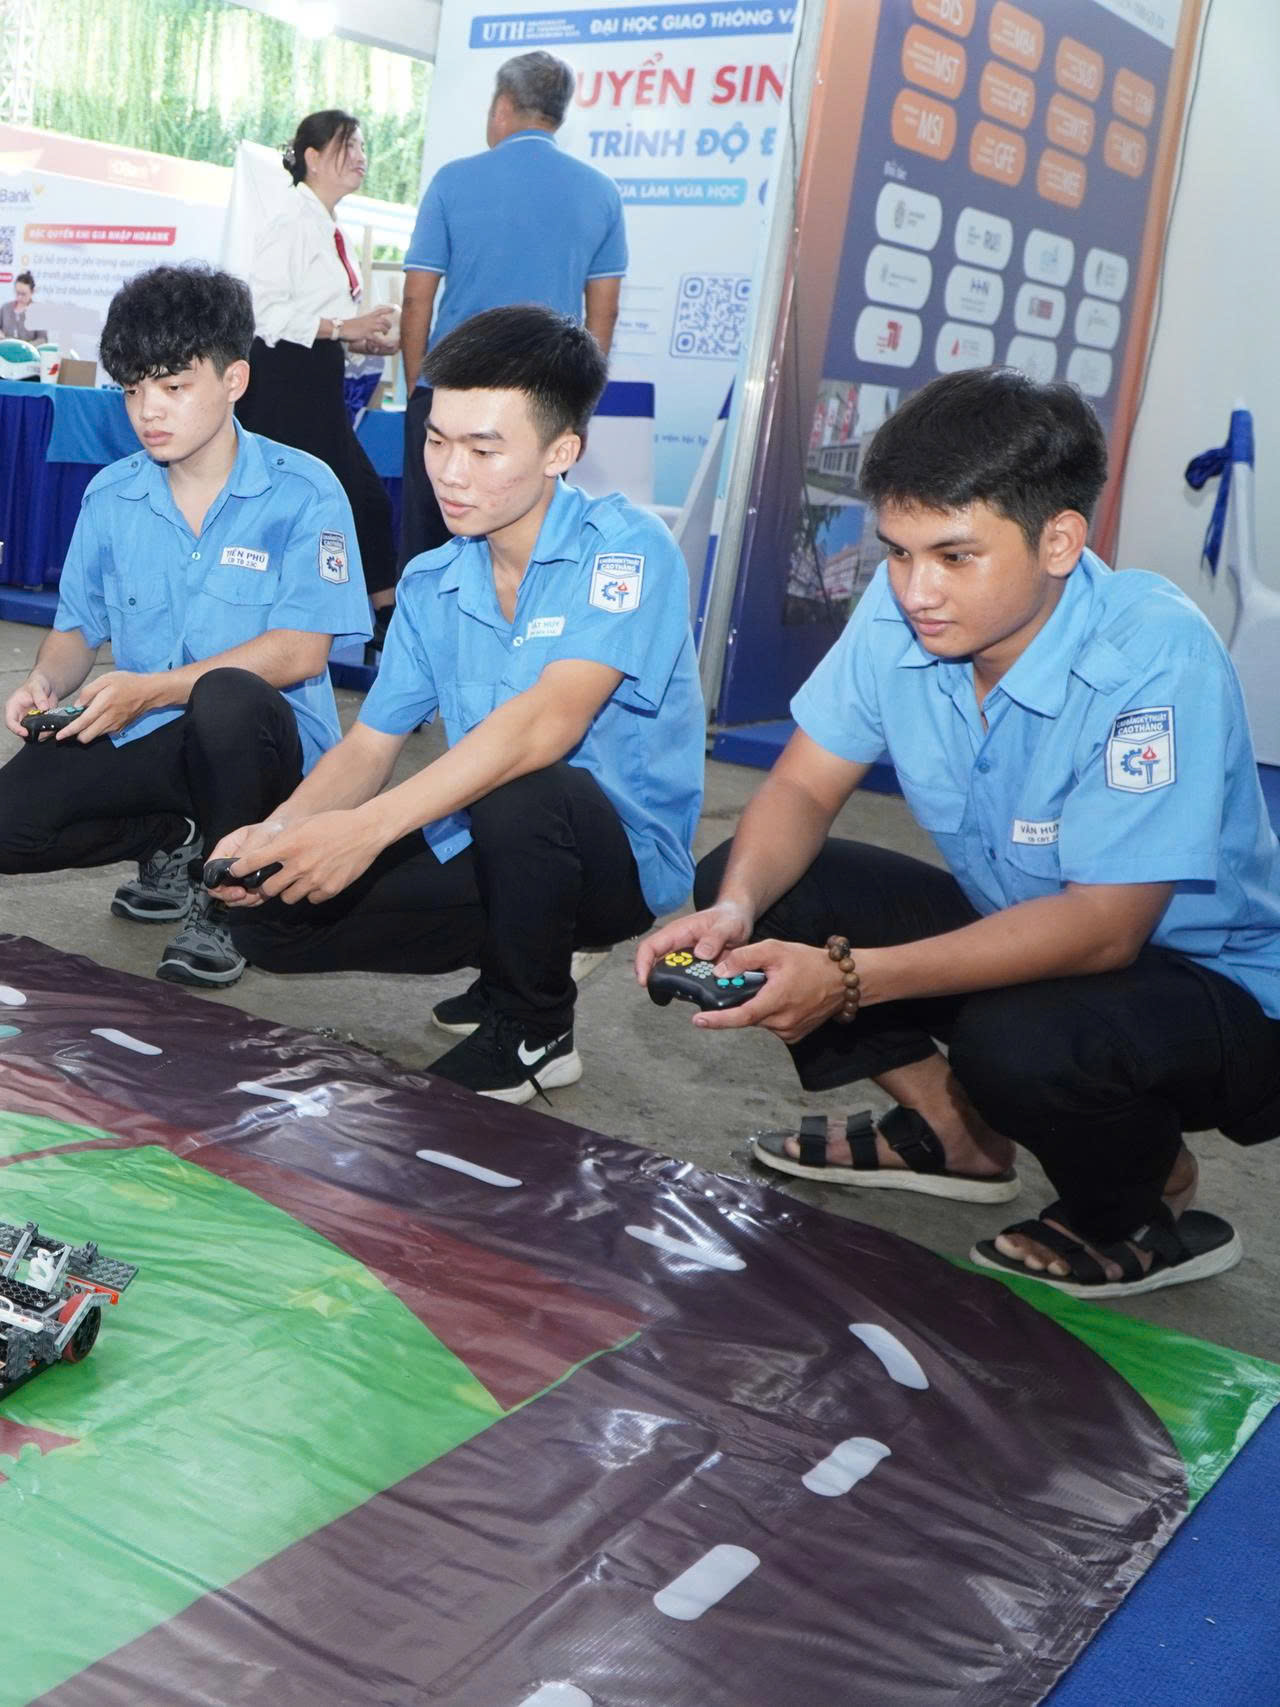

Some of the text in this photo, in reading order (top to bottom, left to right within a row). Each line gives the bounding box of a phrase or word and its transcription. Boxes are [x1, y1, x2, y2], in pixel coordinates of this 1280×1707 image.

[483, 21, 526, 41] UTH
[590, 20, 618, 36] ĐẠI
[623, 16, 657, 33] HỌC
[663, 14, 705, 31] GIAO
[711, 9, 774, 28] THÔNG
[575, 51, 784, 108] UYỂN SIN
[588, 122, 686, 158] TRÌNH
[696, 120, 750, 164] ĐỘ
